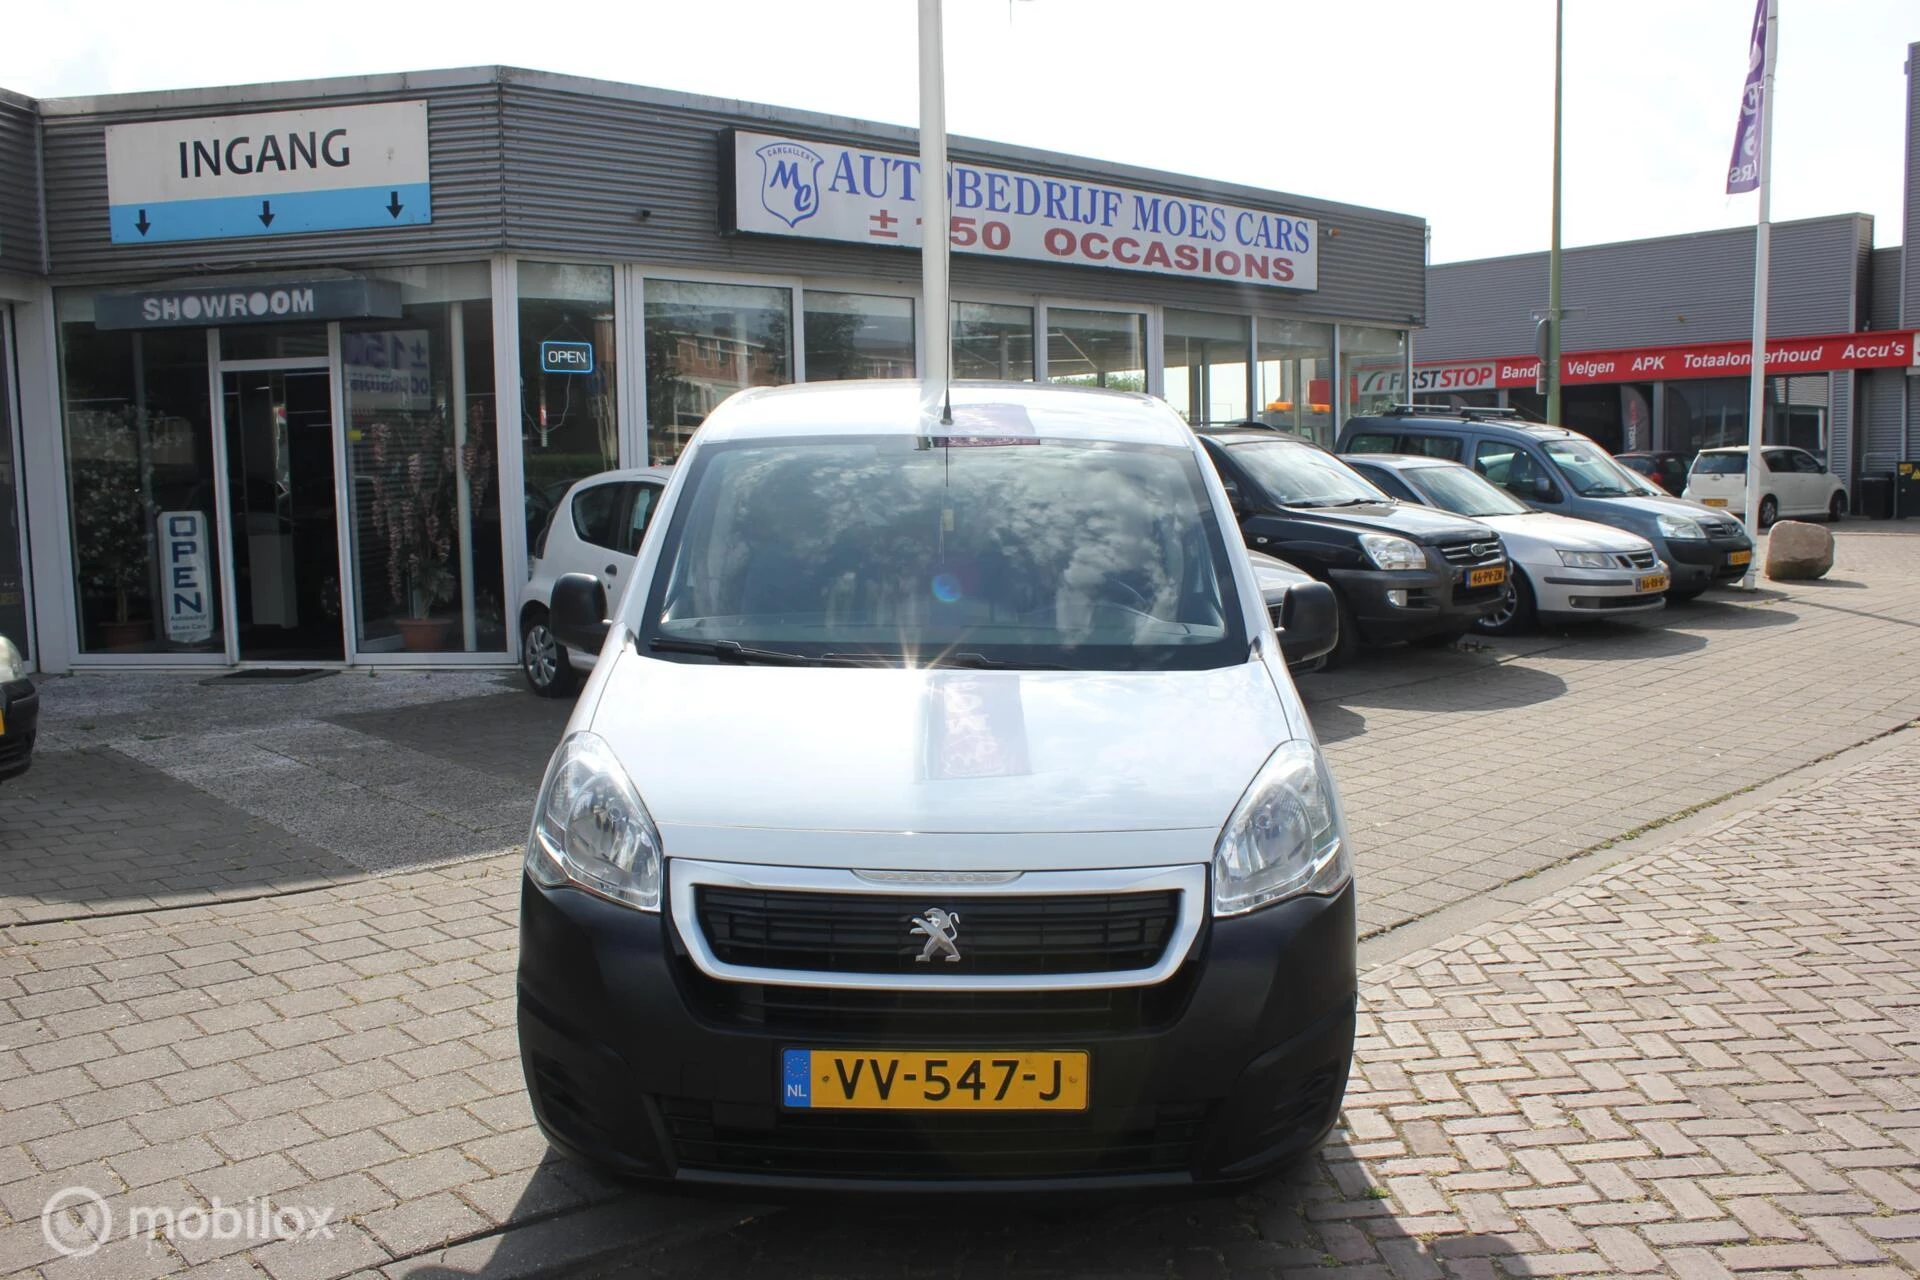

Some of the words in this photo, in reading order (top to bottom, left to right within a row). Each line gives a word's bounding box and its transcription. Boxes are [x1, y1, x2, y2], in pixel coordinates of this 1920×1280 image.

[179, 128, 351, 179] INGANG
[767, 147, 815, 164] CARGALLERY
[828, 151, 1123, 227] AUTBEDRIJF
[1132, 195, 1226, 243] MOES
[1235, 211, 1311, 254] CARS
[916, 216, 1012, 251] 50
[1043, 227, 1296, 283] OCCASIONS
[143, 288, 315, 321] SHOWROOM
[548, 350, 586, 363] OPEN
[1567, 361, 1615, 377] Velgen
[1631, 355, 1665, 372] APK
[1683, 346, 1823, 369] Totaalonerhoud
[1841, 341, 1905, 360] Accu's
[168, 515, 202, 615] OPEN
[787, 1084, 807, 1097] NL
[834, 1058, 1062, 1102] VV-547-J
